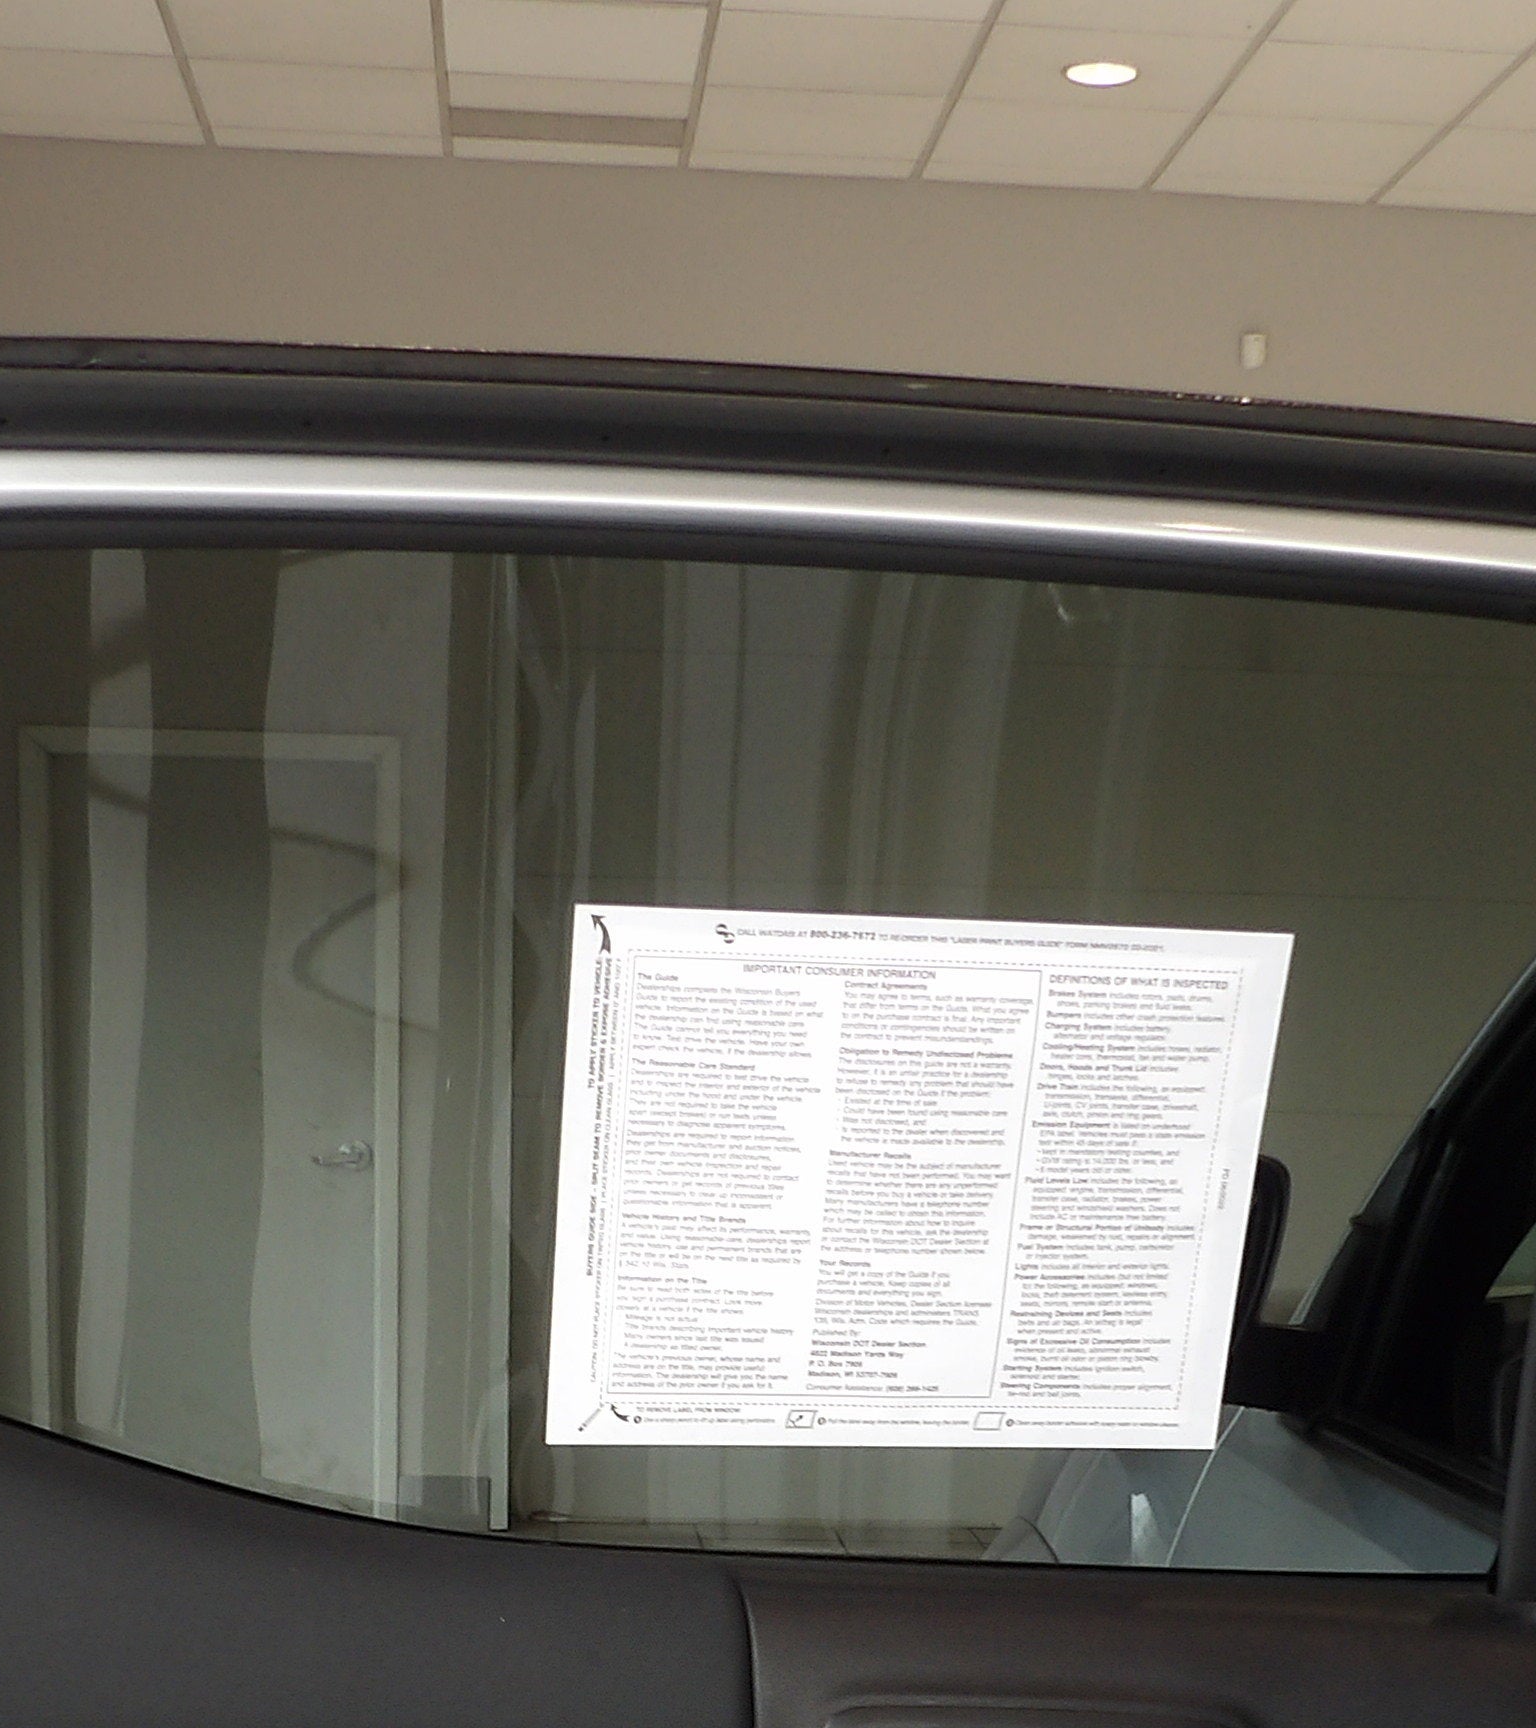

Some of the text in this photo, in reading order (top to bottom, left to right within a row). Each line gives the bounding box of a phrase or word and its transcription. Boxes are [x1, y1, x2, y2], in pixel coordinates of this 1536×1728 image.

[742, 963, 936, 979] IMPORTANT CONSUMER INFORMATION
[602, 957, 612, 999] ADHESIVE
[654, 973, 678, 981] Guide
[1048, 974, 1229, 990] DEFINITIONS OF WHAT IS INSPECTED
[844, 980, 927, 991] Contract Agreements
[1047, 989, 1076, 997] Brakes
[1077, 990, 1107, 999] System
[592, 997, 600, 1008] TO
[600, 1002, 609, 1036] EXPOSE
[1045, 1010, 1082, 1019] Bumpers
[590, 1010, 599, 1046] STICKER
[1044, 1021, 1081, 1030] Charging
[1083, 1022, 1112, 1031] System
[838, 1046, 879, 1055] Obligation
[891, 1048, 923, 1057] Remedy
[925, 1050, 974, 1058] Undisclosed
[976, 1051, 1013, 1059] Problems
[1041, 1042, 1105, 1051] Cooling/Heating
[1106, 1043, 1136, 1052] System
[588, 1049, 597, 1075] APPLY
[597, 1047, 606, 1082] BORDER
[648, 1059, 695, 1067] Reasonable
[719, 1063, 755, 1071] Standard
[1111, 1064, 1133, 1072] Trunk
[587, 1078, 595, 1088] TO
[1036, 1082, 1057, 1090] Drive
[1059, 1082, 1079, 1090] Train
[595, 1085, 603, 1120] REMOVE
[594, 1122, 601, 1133] TO
[592, 1136, 600, 1160] SEAM
[828, 1150, 881, 1158] Manufacturer
[591, 1163, 599, 1185] SPLIT
[589, 1195, 597, 1213] SIDE
[588, 1216, 596, 1241] GUIDE
[586, 1243, 594, 1276] BUYERS
[1009, 1309, 1053, 1317] Restraining
[852, 1339, 869, 1347] DOT
[1005, 1337, 1028, 1345] Signs
[1038, 1337, 1077, 1345] Excessive
[1078, 1337, 1090, 1345] Oil
[1090, 1337, 1141, 1345] Consumption
[1034, 1364, 1062, 1372] System
